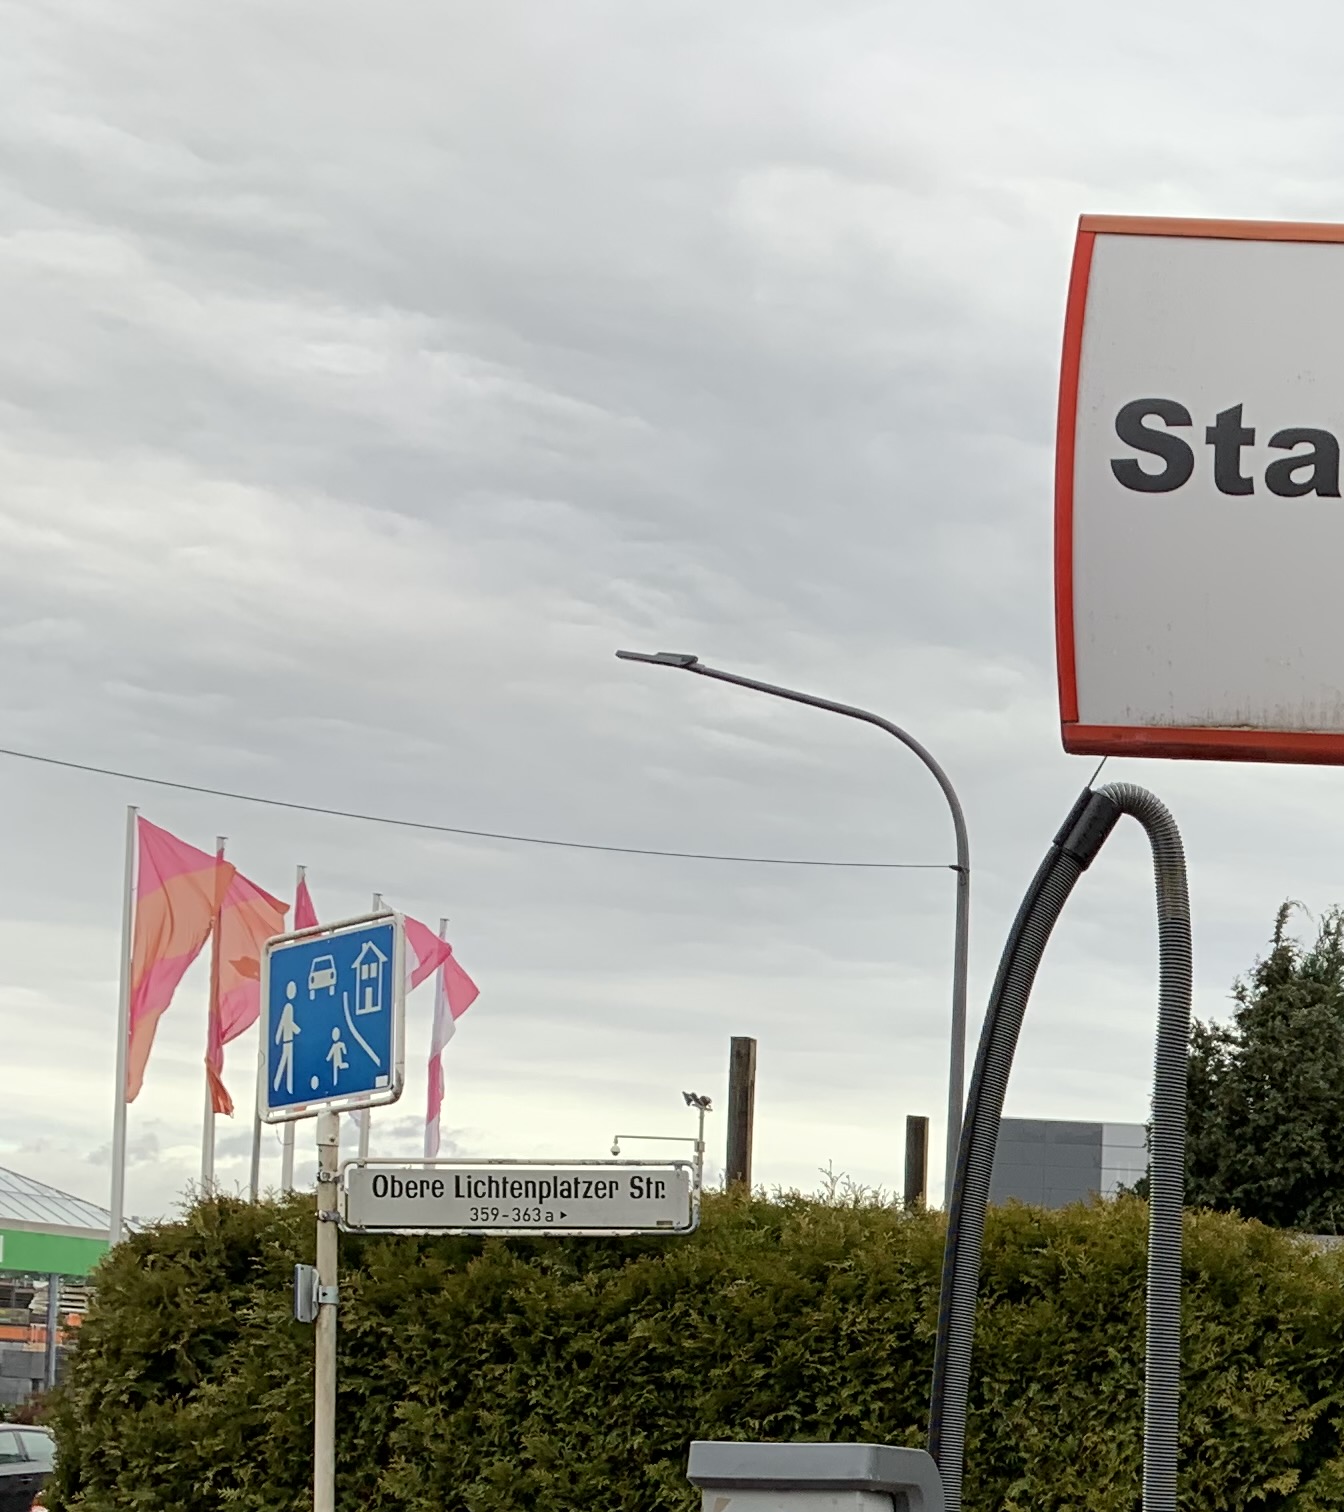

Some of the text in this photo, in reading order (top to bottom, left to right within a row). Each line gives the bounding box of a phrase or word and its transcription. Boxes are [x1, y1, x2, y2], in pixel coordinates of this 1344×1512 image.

[371, 1174, 667, 1205] Obere Lichtenplatzer Str.
